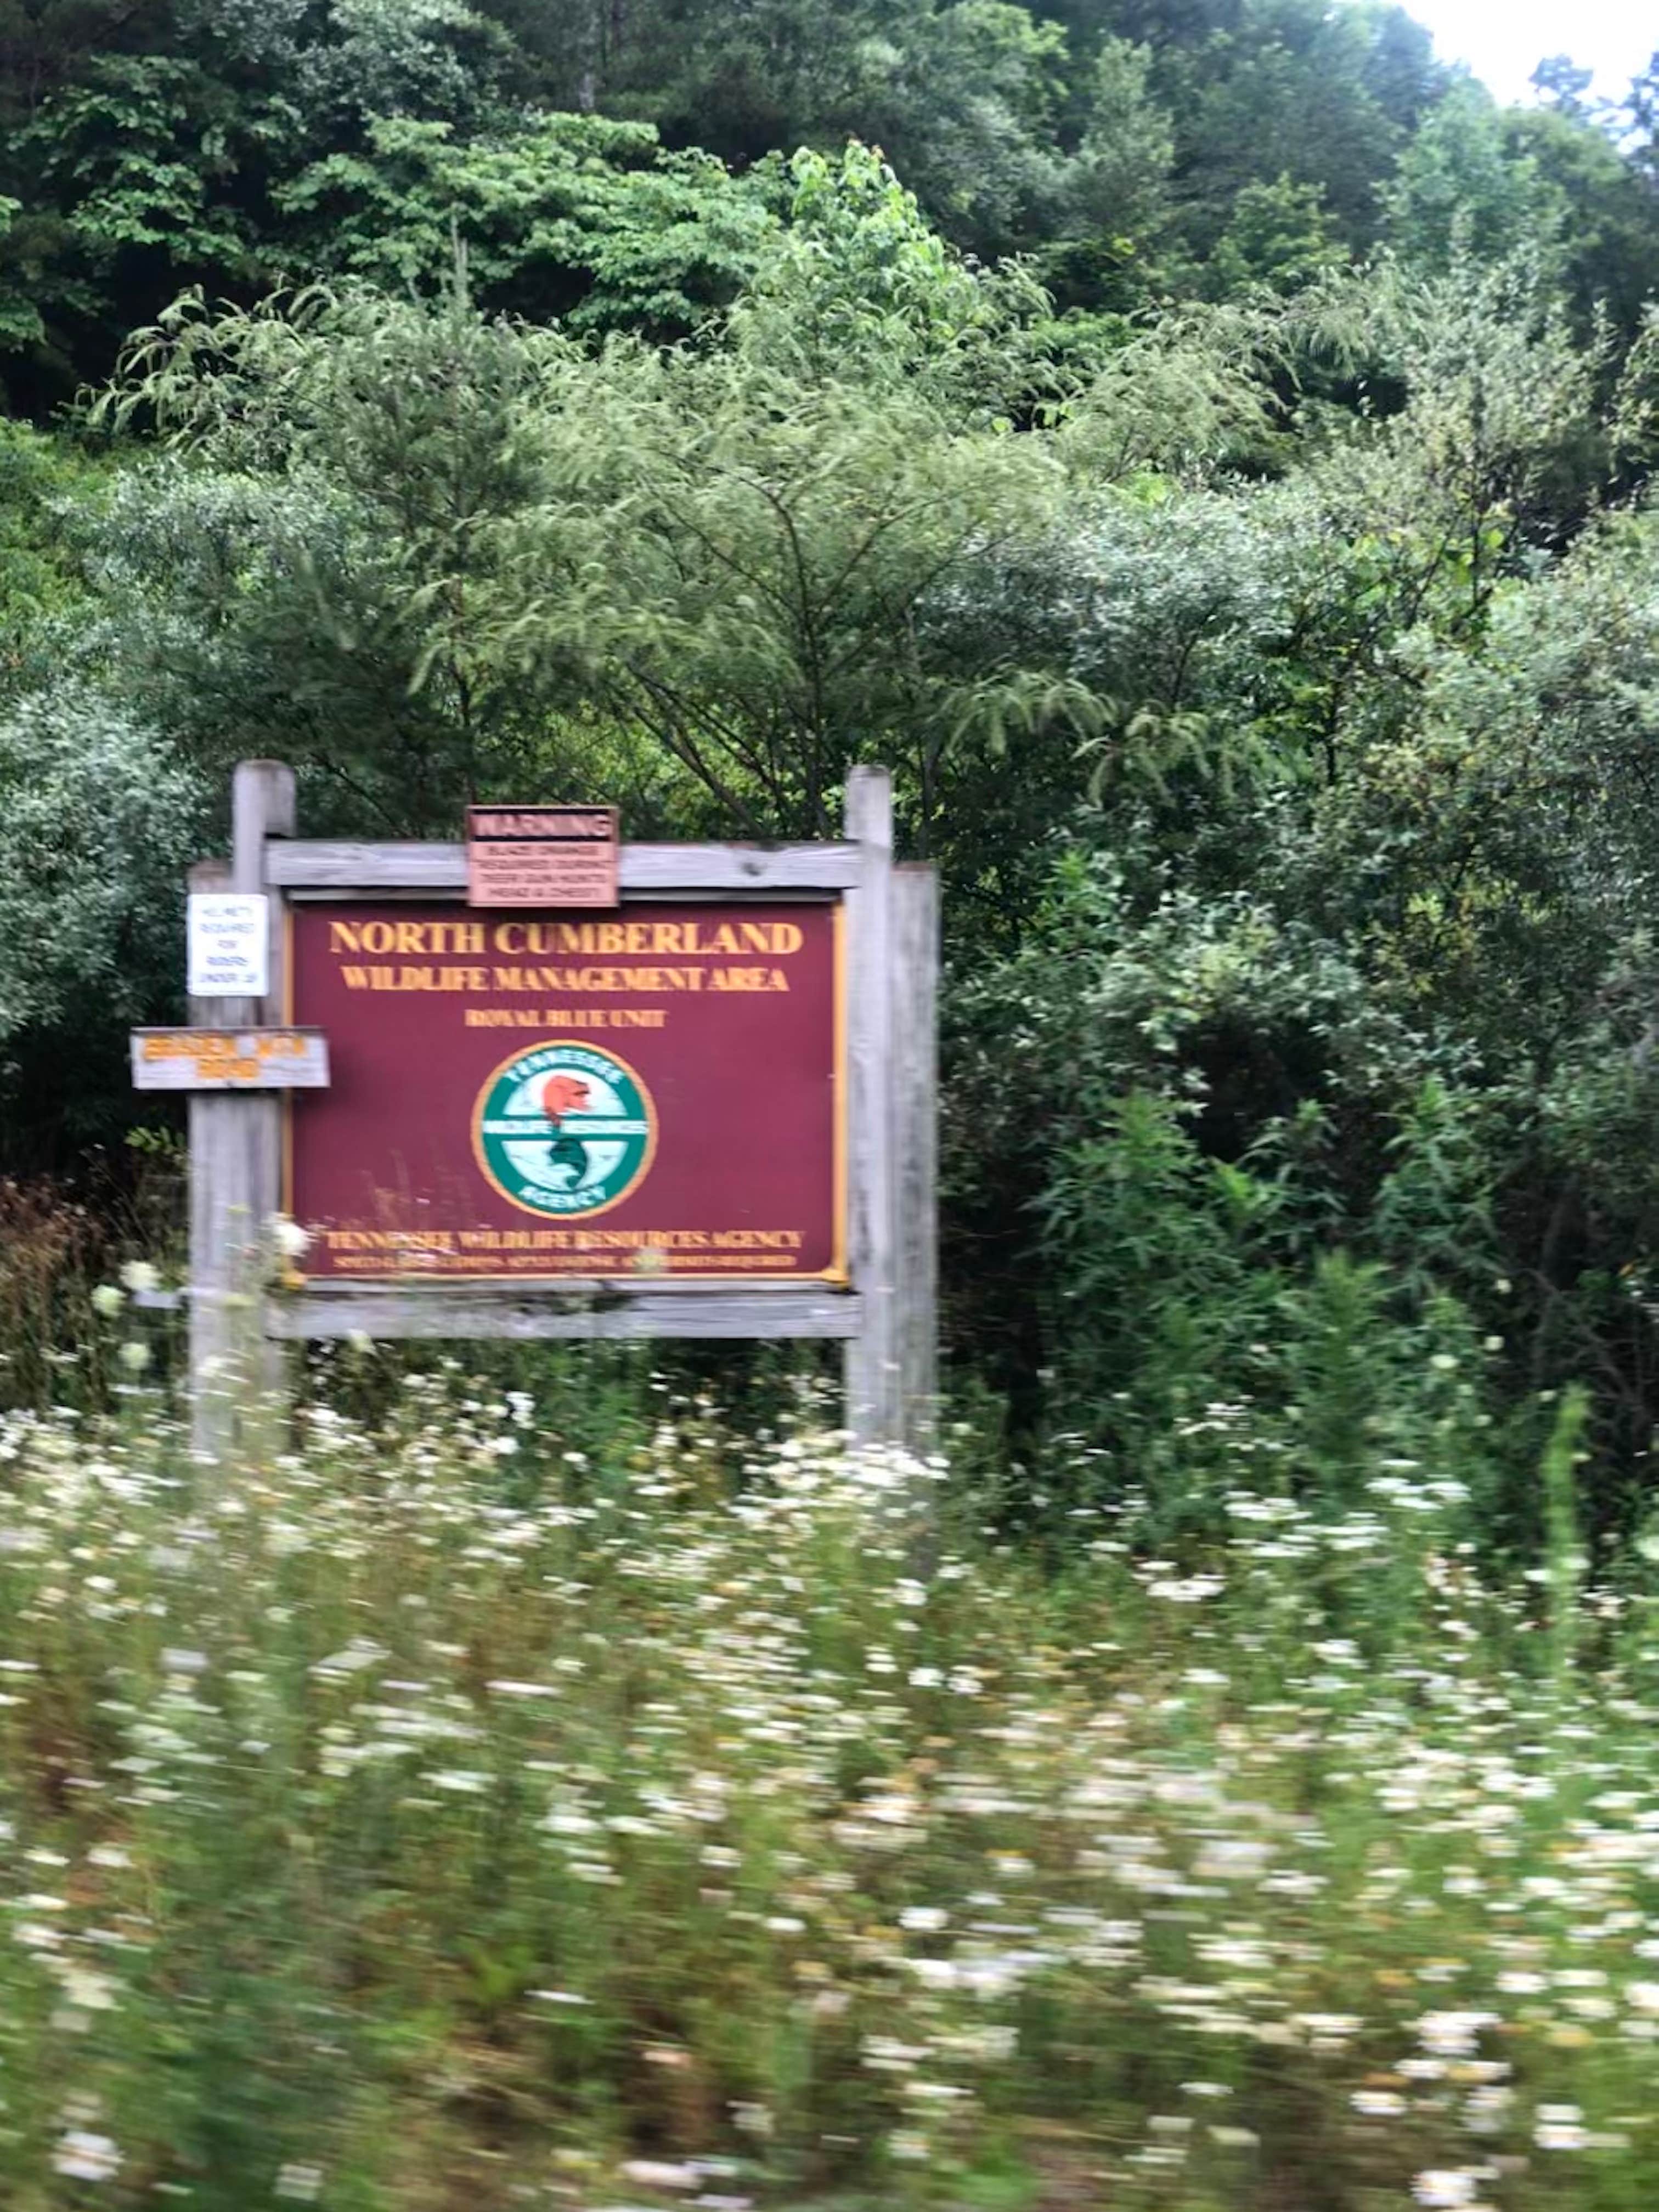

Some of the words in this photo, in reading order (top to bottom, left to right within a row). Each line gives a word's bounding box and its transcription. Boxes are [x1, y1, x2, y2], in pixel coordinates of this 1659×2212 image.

[473, 814, 612, 837] WARNING
[329, 921, 487, 954] NORTH
[495, 922, 804, 955] CUMBERLAND
[339, 966, 489, 991] WILDLIFE
[491, 967, 707, 992] MANAGEMENT
[707, 968, 791, 992] AREA
[464, 1009, 541, 1027] ROYAL
[544, 1009, 608, 1027] BLUE
[608, 1009, 668, 1027] UNIT
[456, 1231, 572, 1249] WILDLIFE
[573, 1231, 708, 1248] RESOURCES
[709, 1230, 806, 1248] AGENCY
